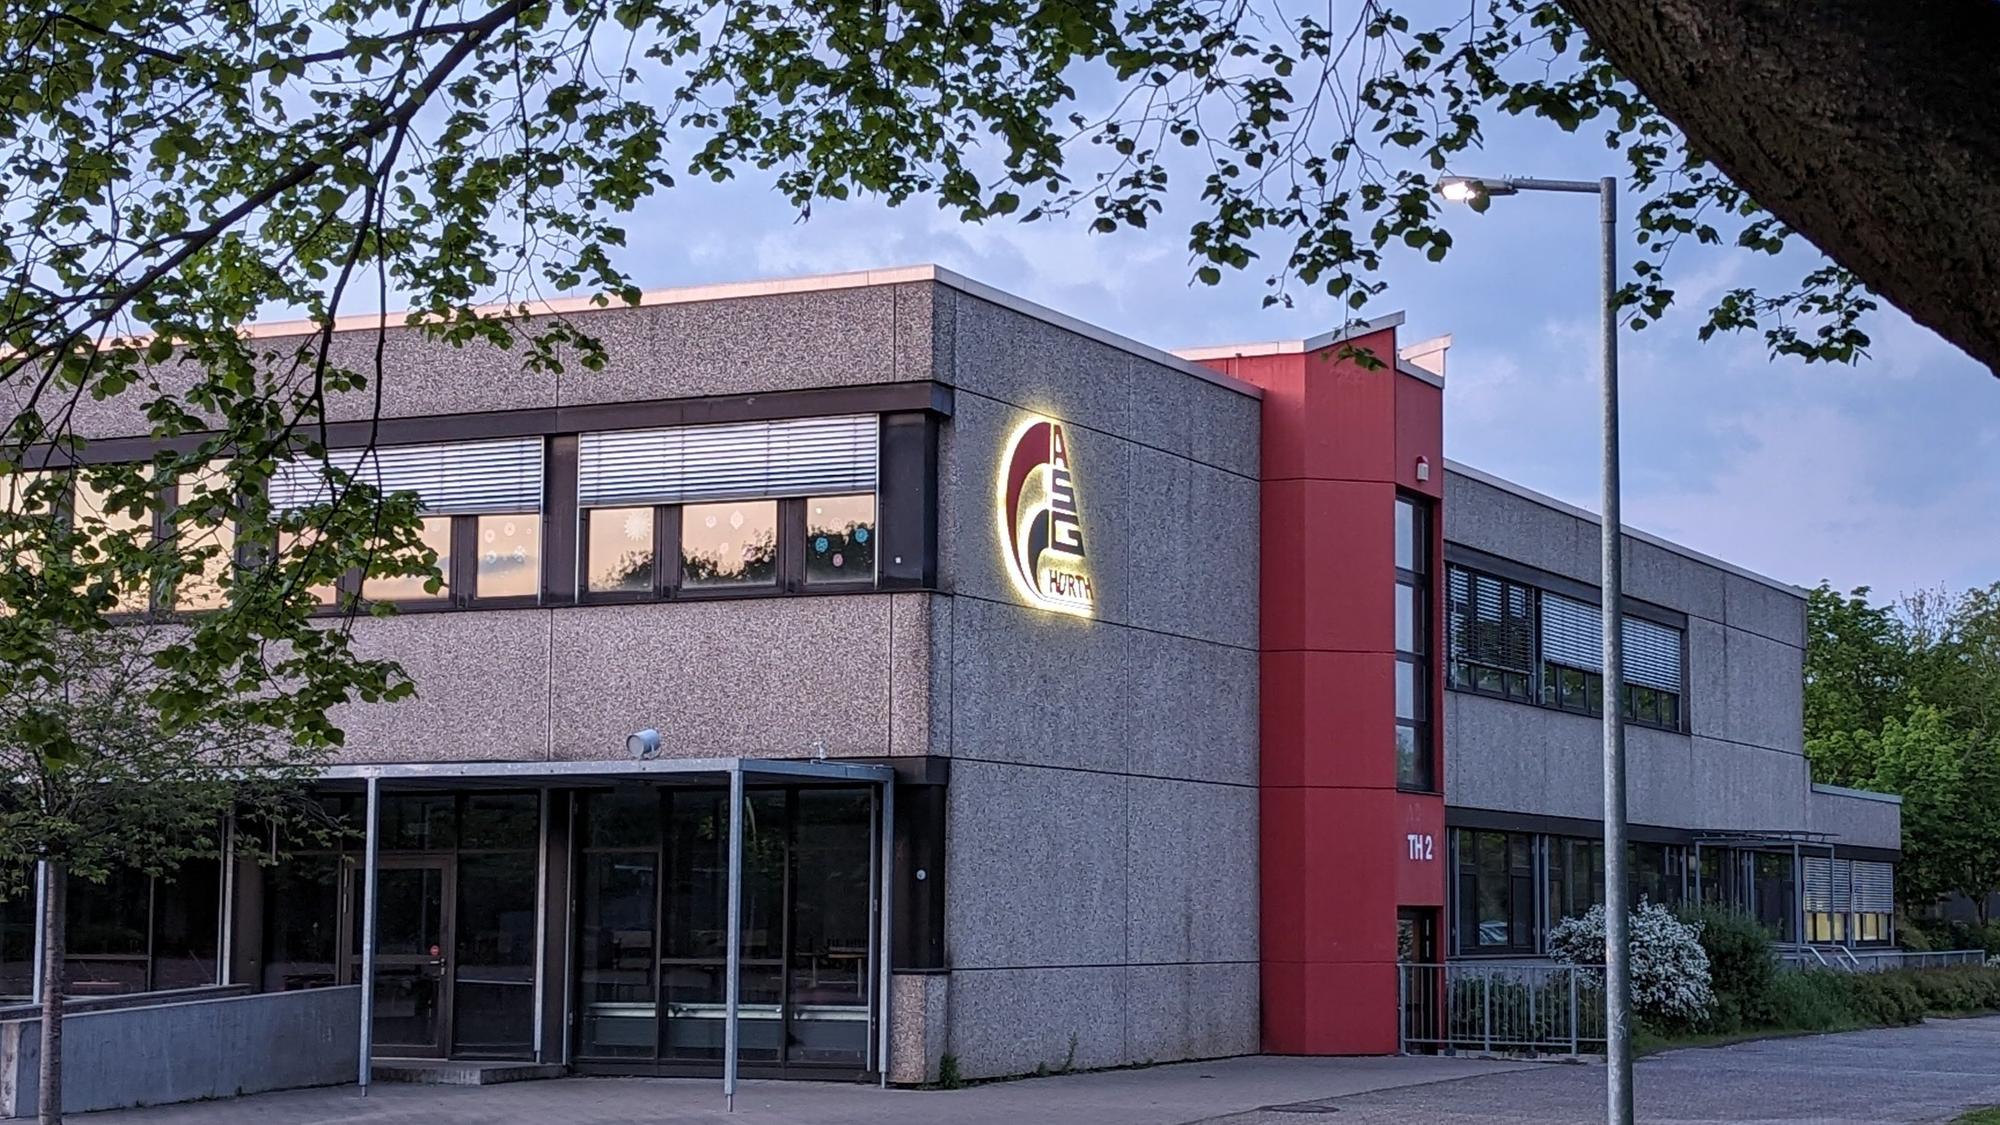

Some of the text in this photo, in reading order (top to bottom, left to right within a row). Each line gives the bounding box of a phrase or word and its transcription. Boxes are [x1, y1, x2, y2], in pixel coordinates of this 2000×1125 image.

[1051, 424, 1086, 557] ASG
[1407, 834, 1433, 860] TH 2
